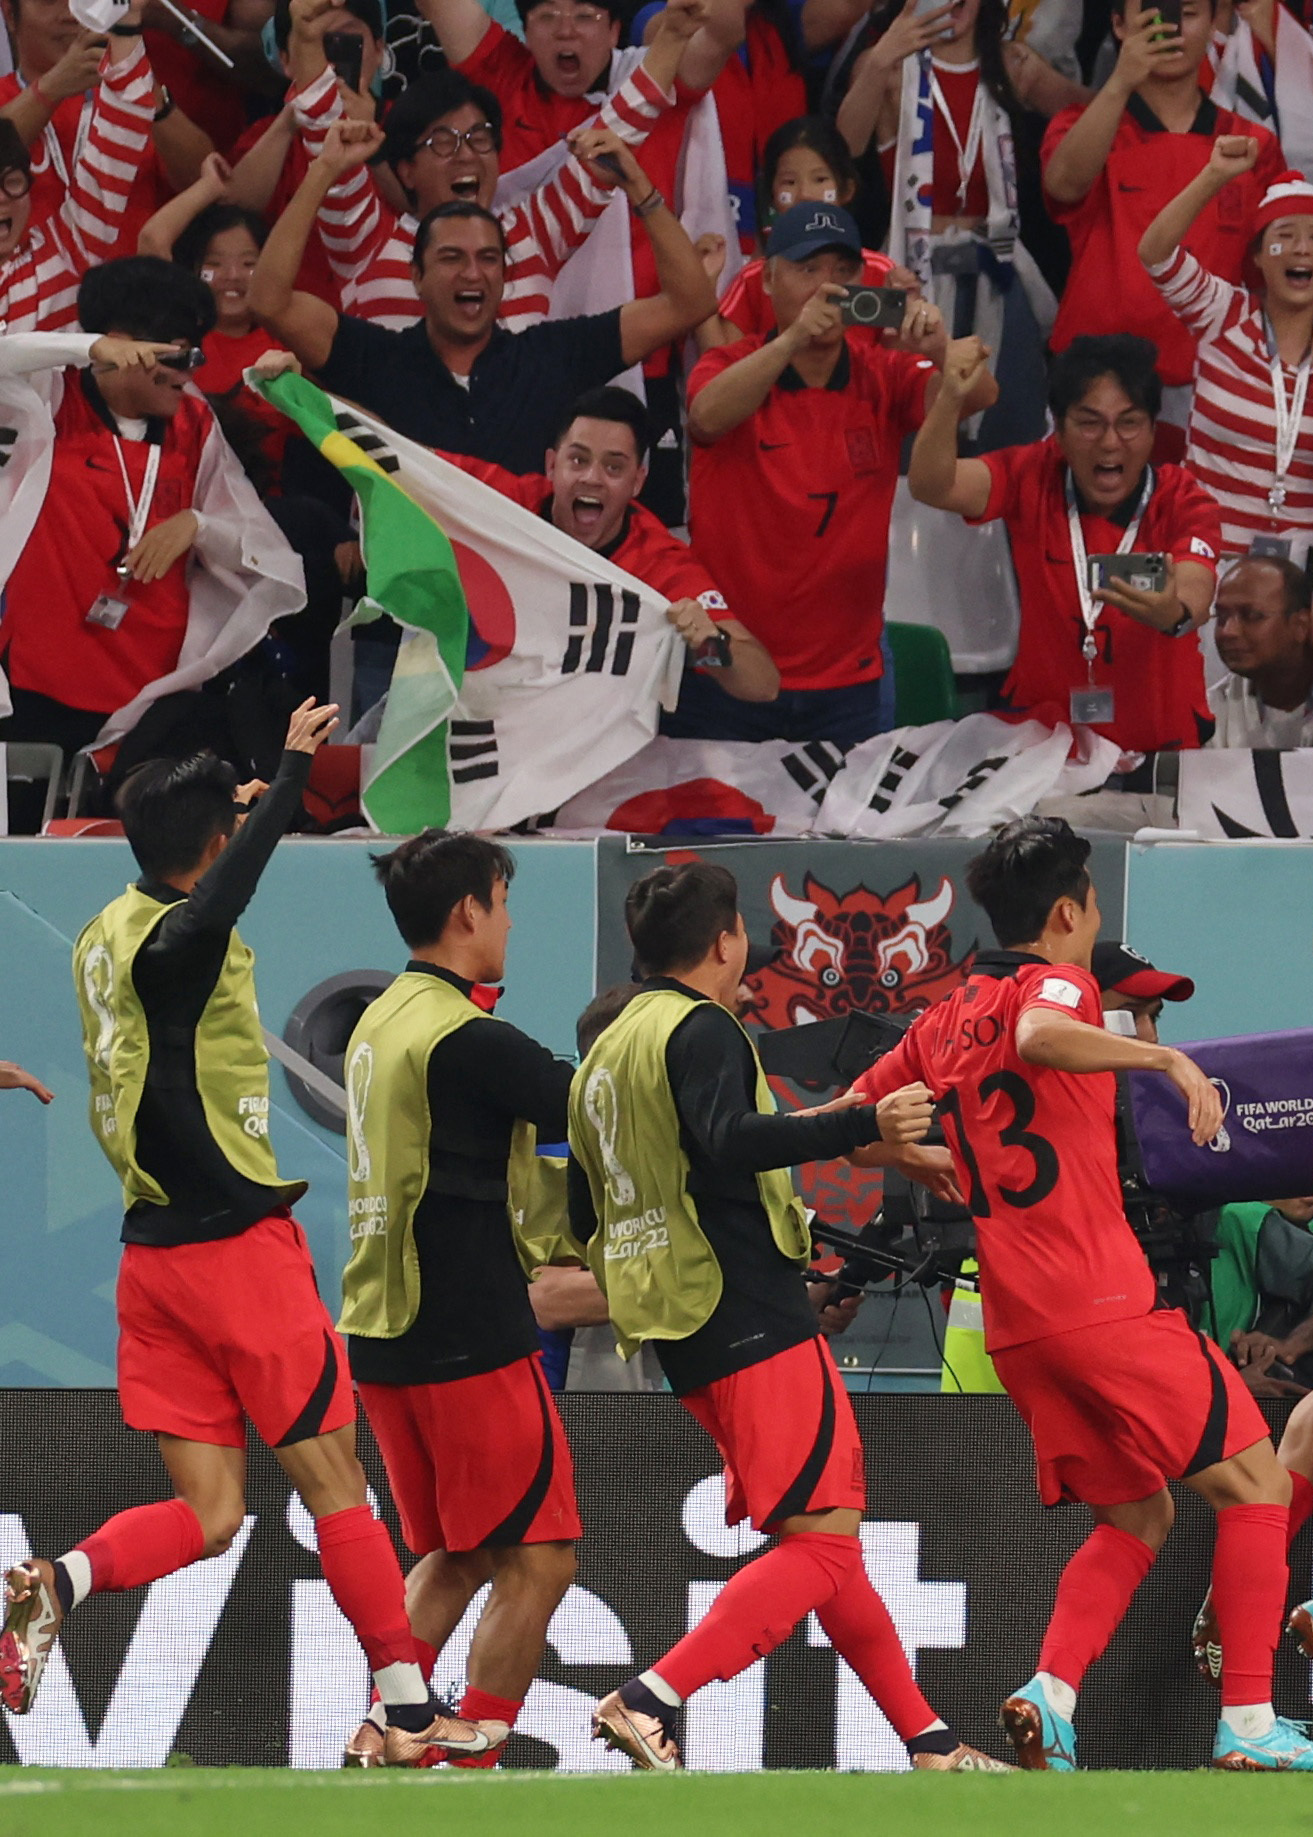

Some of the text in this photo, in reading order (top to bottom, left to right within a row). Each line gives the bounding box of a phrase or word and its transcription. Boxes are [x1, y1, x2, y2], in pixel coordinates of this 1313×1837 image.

[807, 491, 838, 537] 7
[961, 1014, 1006, 1051] SO
[1236, 1102, 1266, 1117] FIFA
[936, 1069, 1060, 1218] 13
[0, 1473, 967, 1769] Visit
